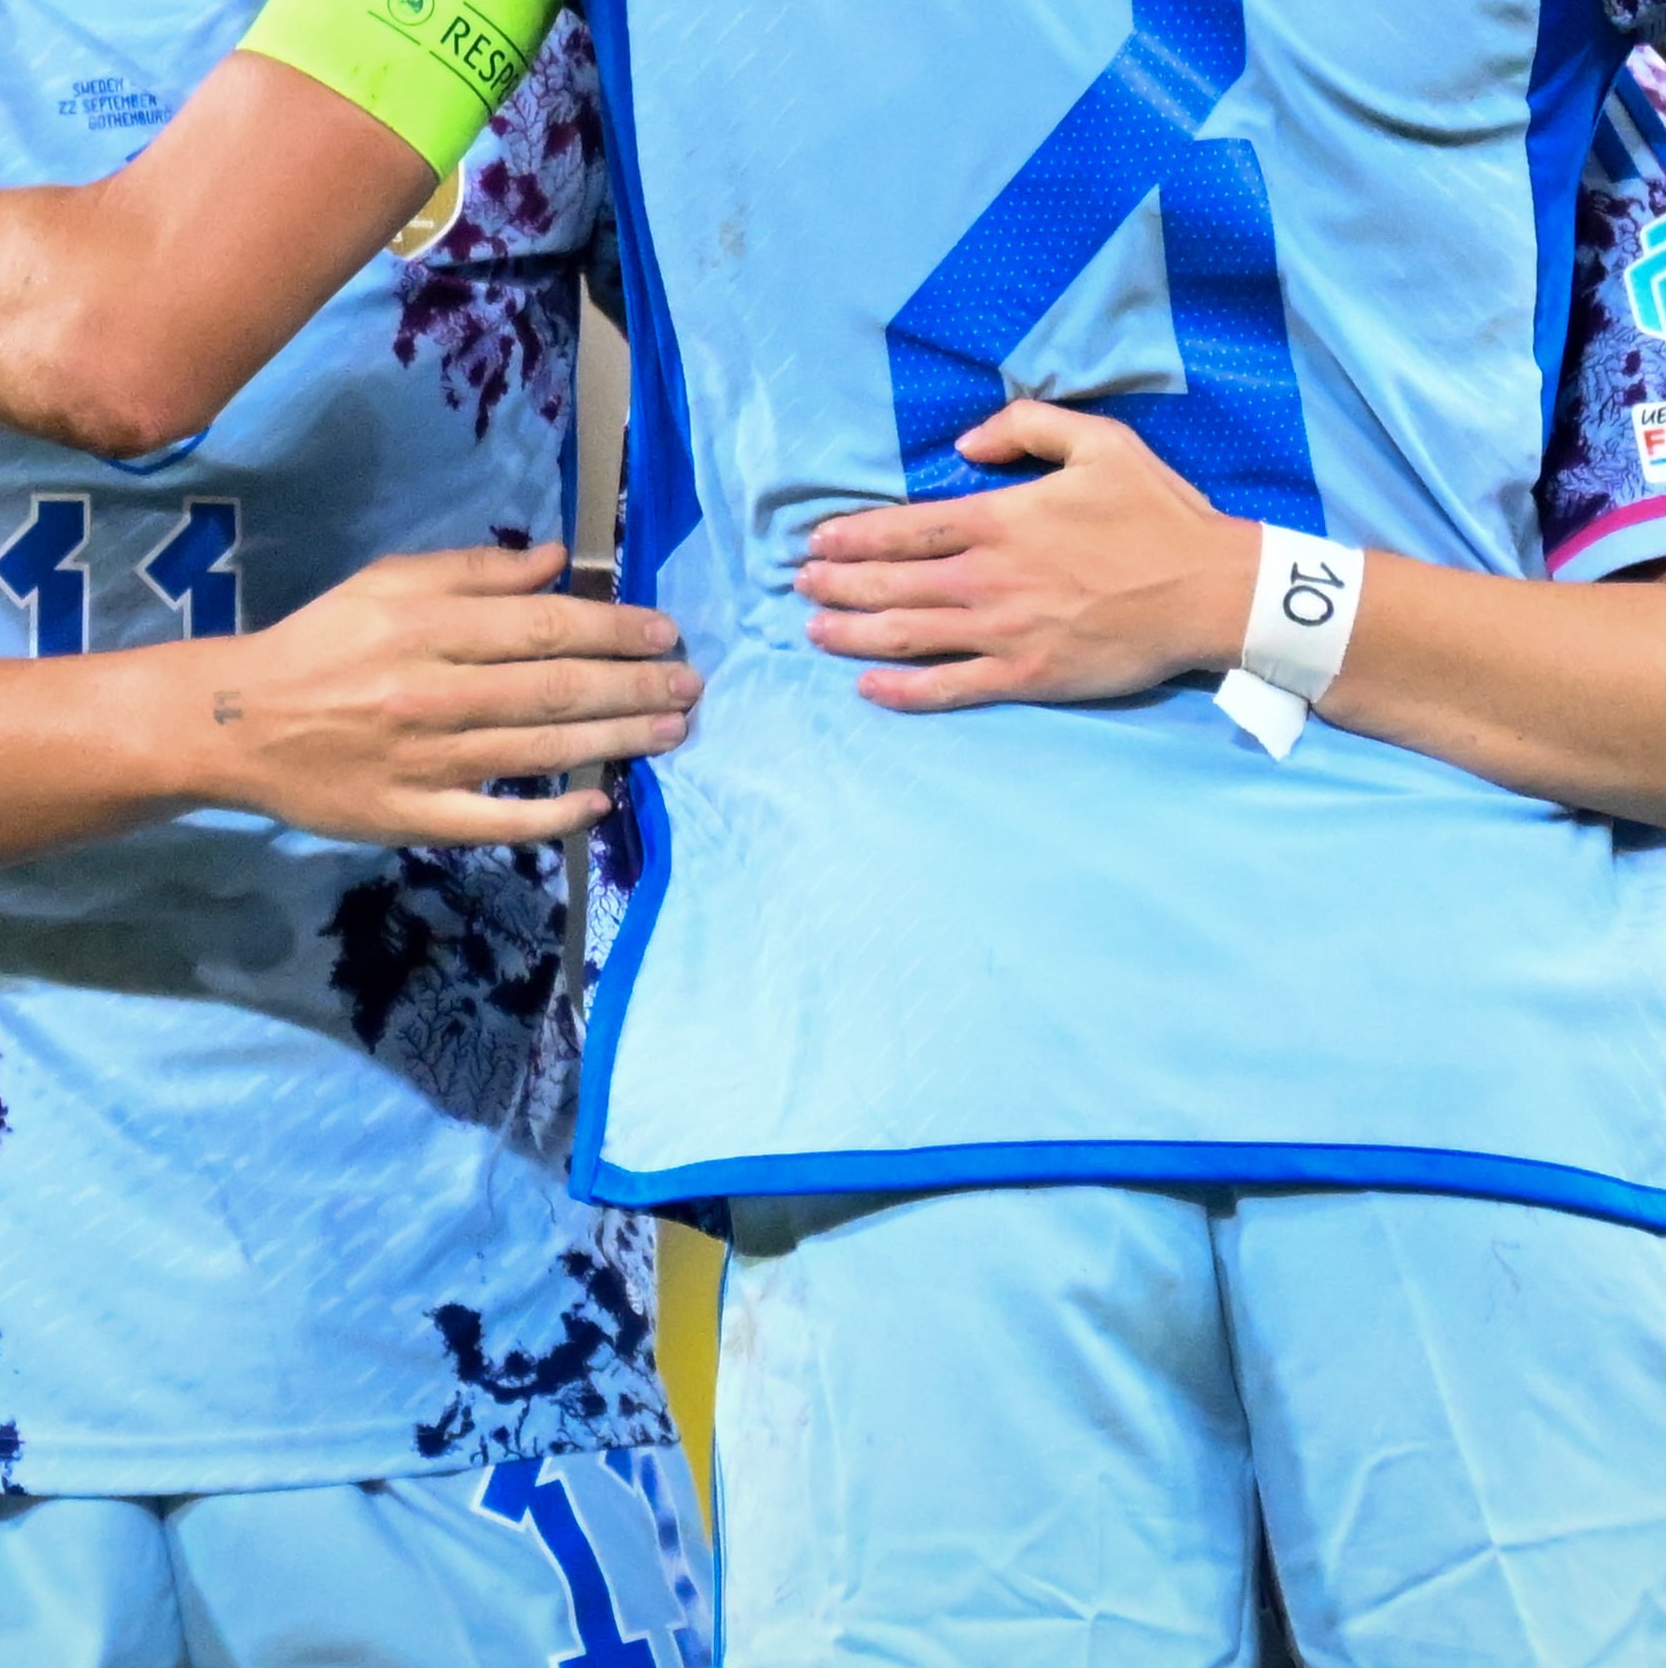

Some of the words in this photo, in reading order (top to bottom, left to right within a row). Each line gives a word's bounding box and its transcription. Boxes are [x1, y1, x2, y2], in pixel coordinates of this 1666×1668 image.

[72, 77, 124, 98] SWEDEN
[58, 100, 77, 115] 22
[84, 93, 157, 114] SEPTEMBER
[1282, 561, 1345, 627] 10
